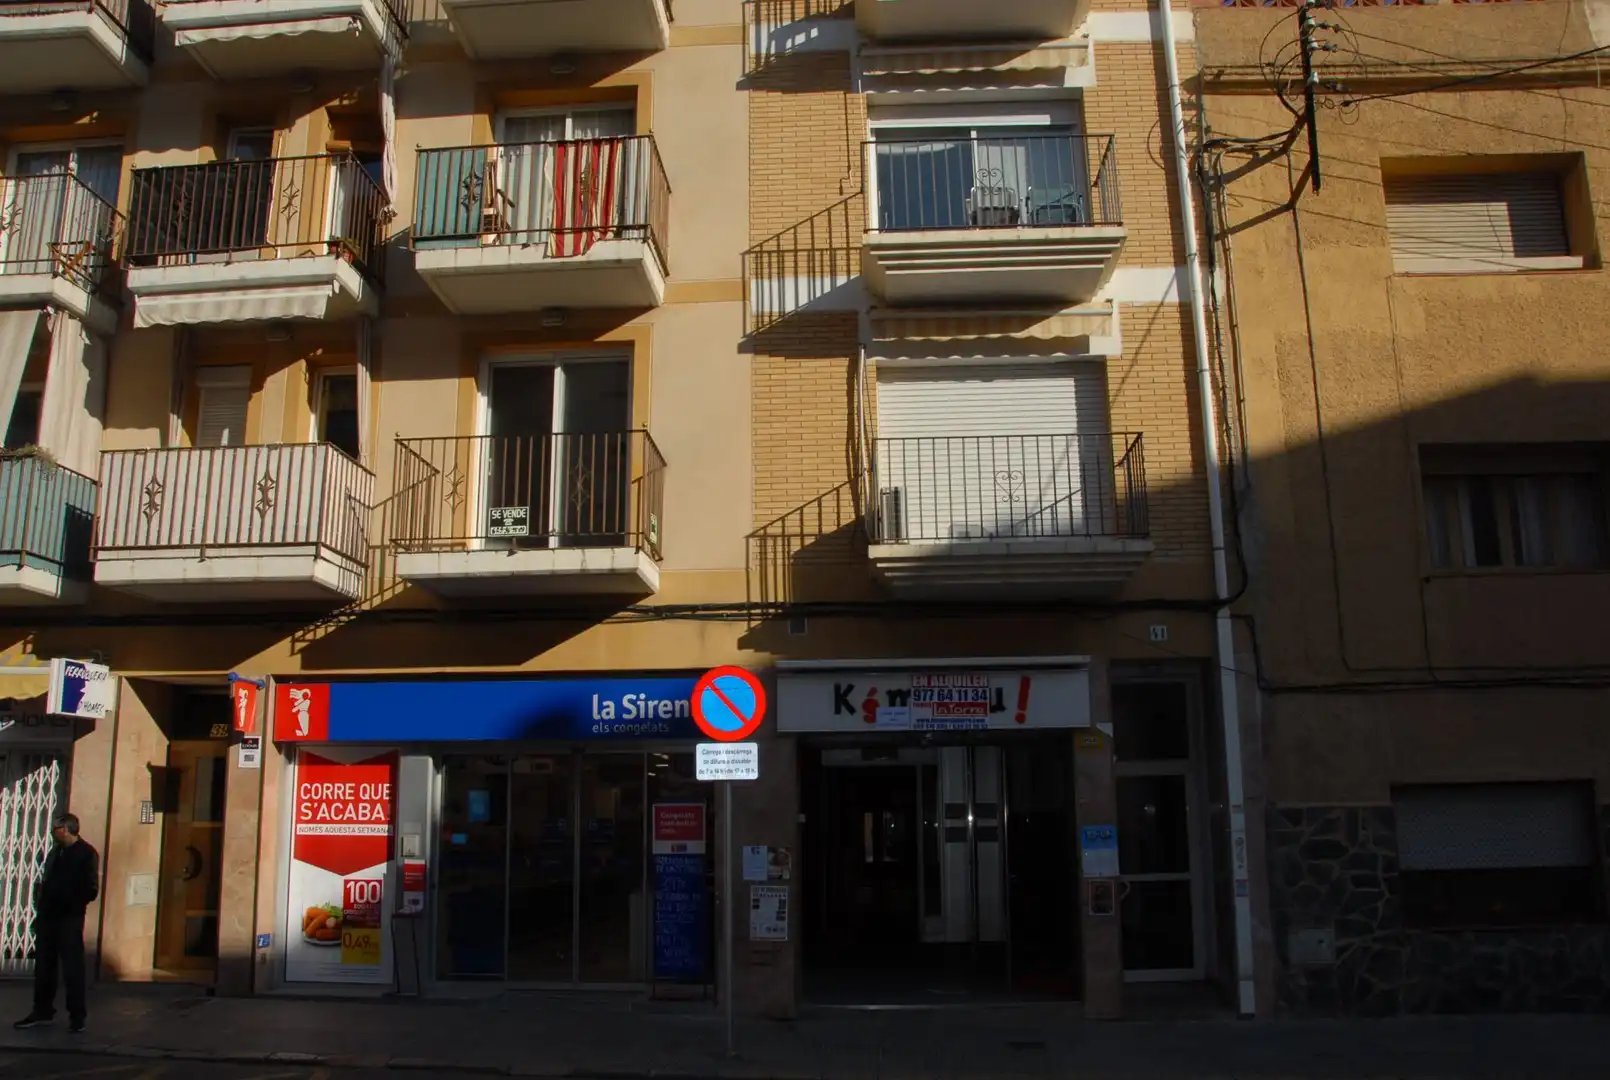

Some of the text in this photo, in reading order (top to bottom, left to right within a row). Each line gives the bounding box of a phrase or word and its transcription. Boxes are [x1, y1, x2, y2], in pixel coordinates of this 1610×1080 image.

[492, 509, 526, 519] SE VENDE
[912, 675, 988, 687] EN ALQUILER
[912, 688, 988, 702] 977 64 11 34
[592, 692, 689, 720] la Siren
[592, 721, 670, 736] els congelats
[300, 783, 393, 800] CORRE QUE
[324, 825, 356, 834] AQUESTA
[346, 880, 381, 904] 100
